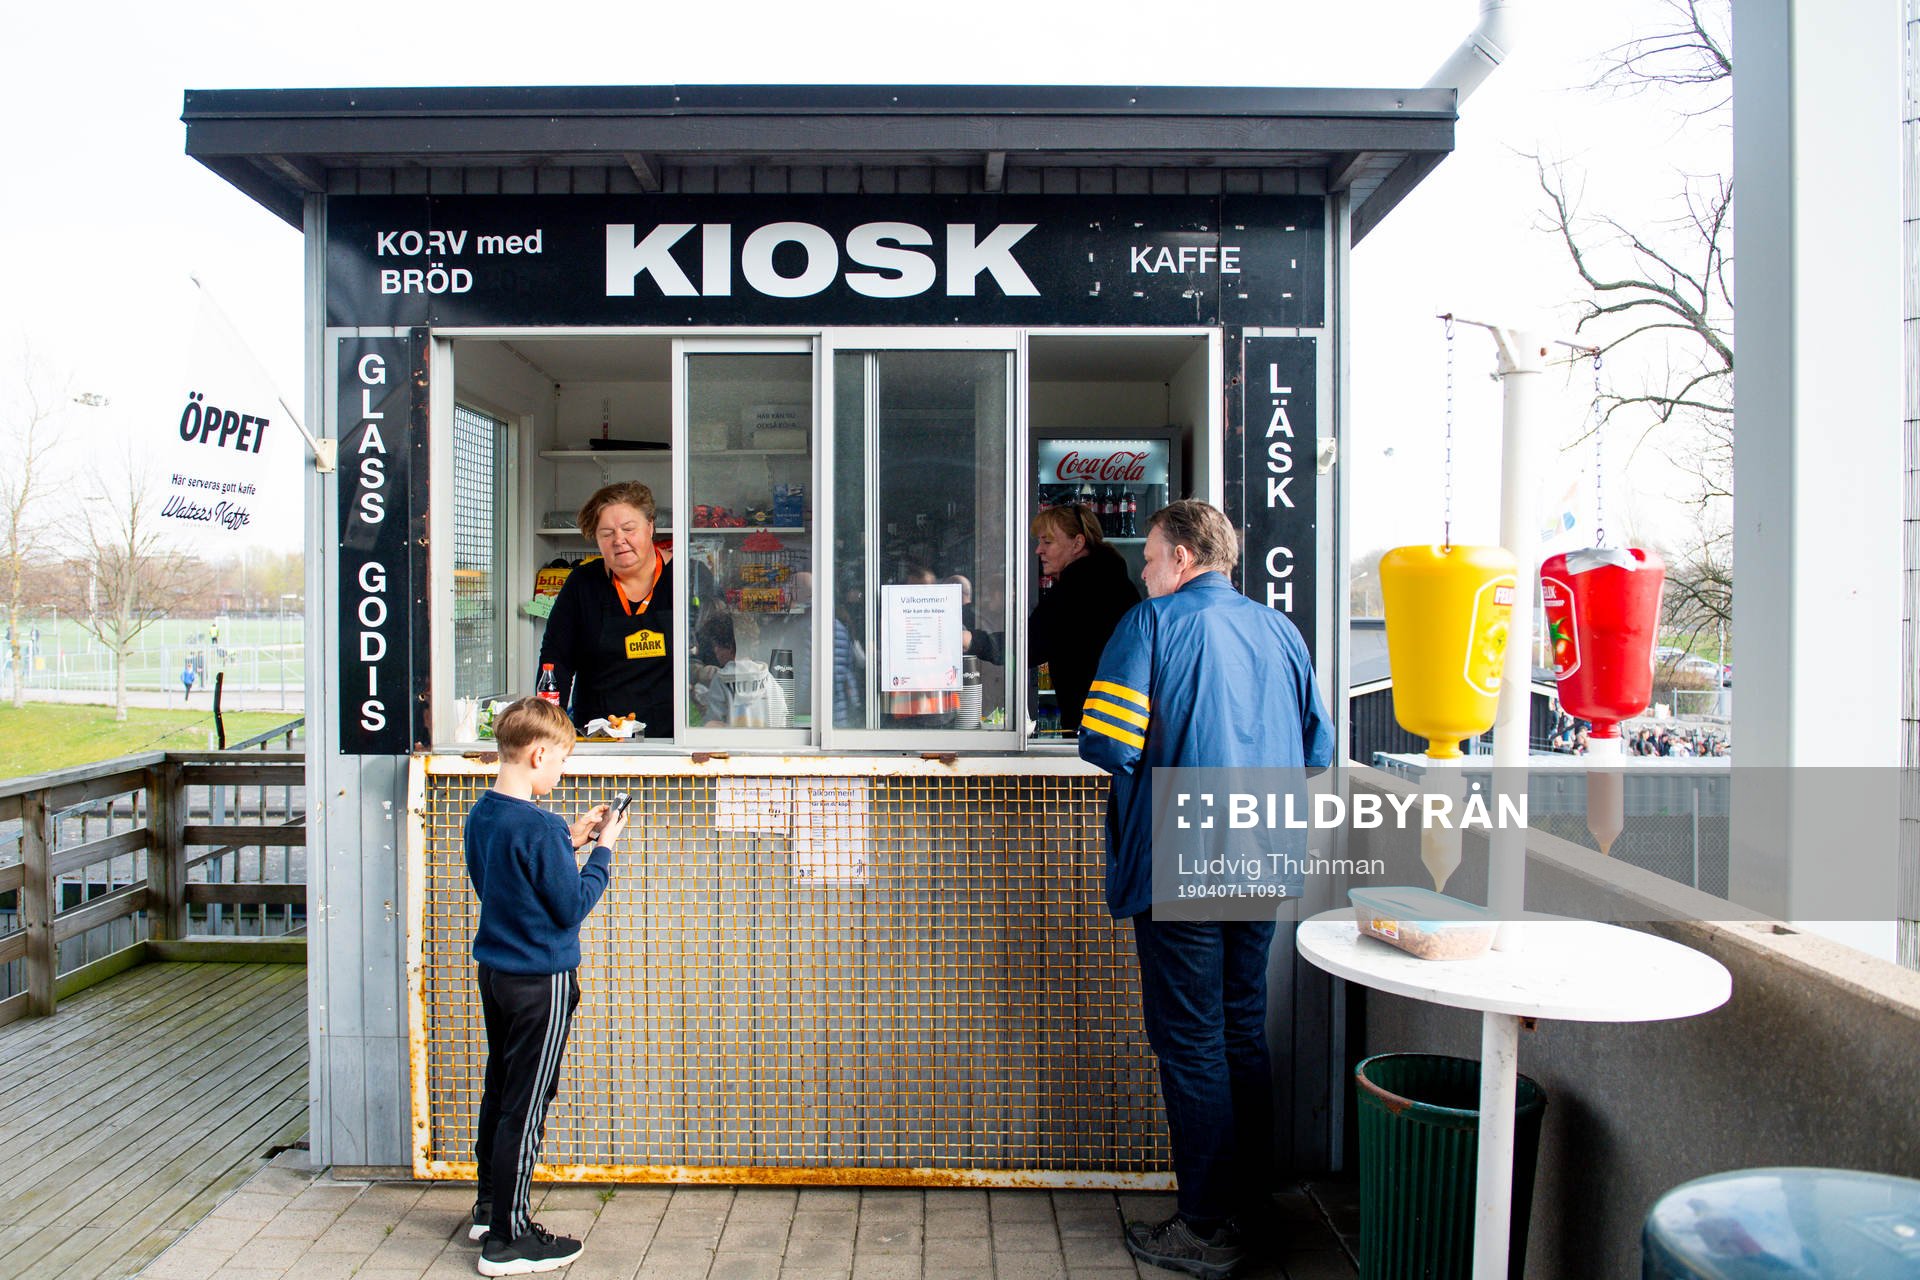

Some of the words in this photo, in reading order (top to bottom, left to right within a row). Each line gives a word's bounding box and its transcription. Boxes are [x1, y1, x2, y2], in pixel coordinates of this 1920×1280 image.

[377, 230, 468, 256] KORV
[477, 229, 543, 254] med
[606, 221, 1041, 298] KIOSK
[1130, 246, 1241, 273] KAFFE
[381, 263, 473, 294] BRÖD
[179, 391, 270, 454] ÖPPET
[358, 353, 387, 524] GLASS
[1265, 363, 1295, 508] LÄSK
[1056, 451, 1150, 481] Coca-Cola
[171, 473, 187, 486] Här
[187, 476, 220, 491] serveras
[221, 482, 237, 494] gott
[238, 482, 257, 496] kaffe
[161, 495, 213, 522] Walters
[215, 501, 250, 530] Kaffe
[358, 561, 387, 731] GODIS
[629, 640, 662, 652] CHARK
